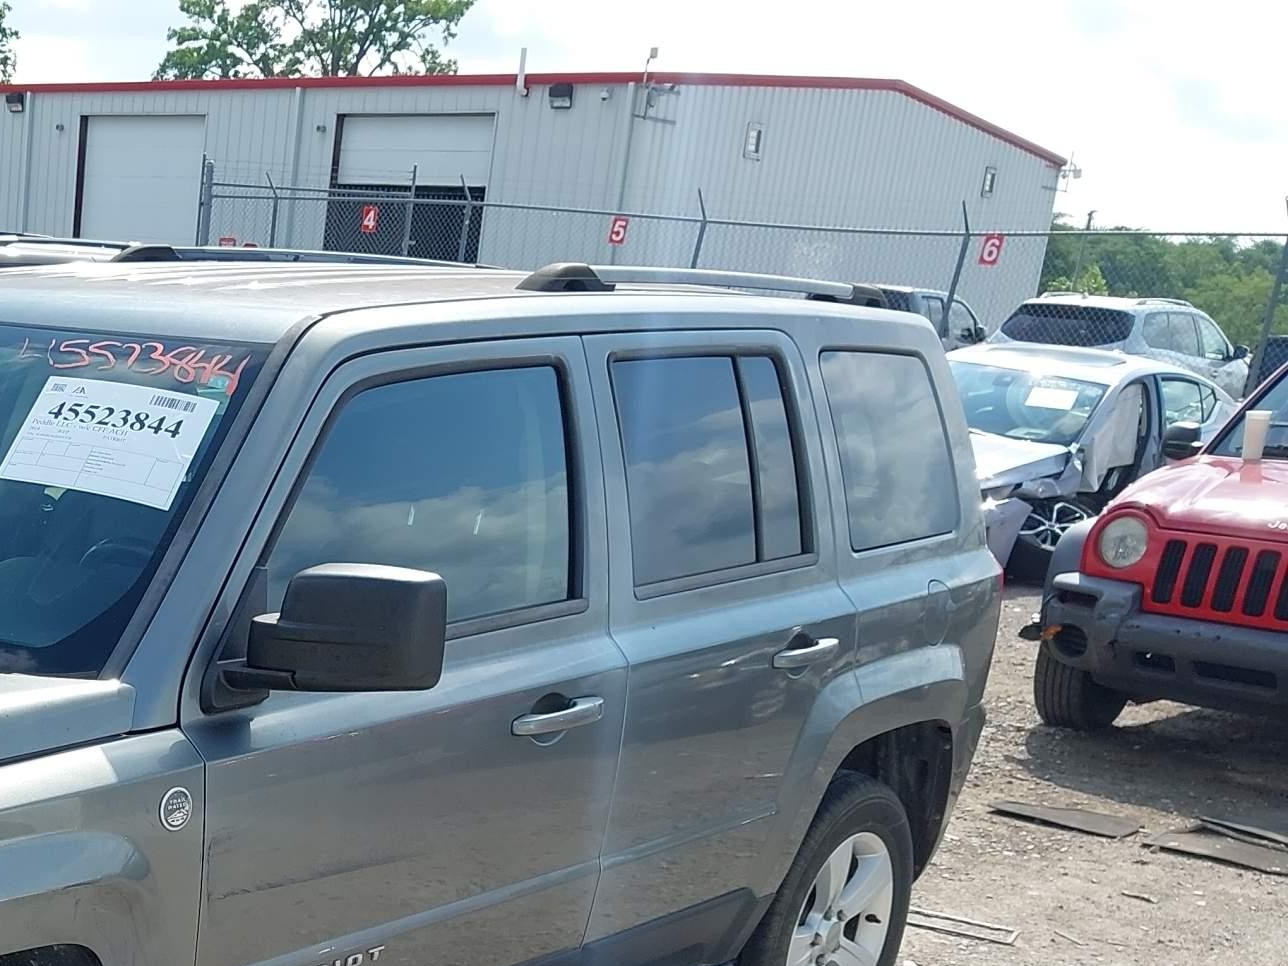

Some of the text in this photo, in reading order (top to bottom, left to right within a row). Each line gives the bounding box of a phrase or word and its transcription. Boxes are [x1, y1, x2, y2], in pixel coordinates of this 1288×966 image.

[363, 209, 375, 230] 4
[612, 220, 626, 241] 5
[983, 238, 1000, 261] 6
[47, 401, 184, 439] 45523844
